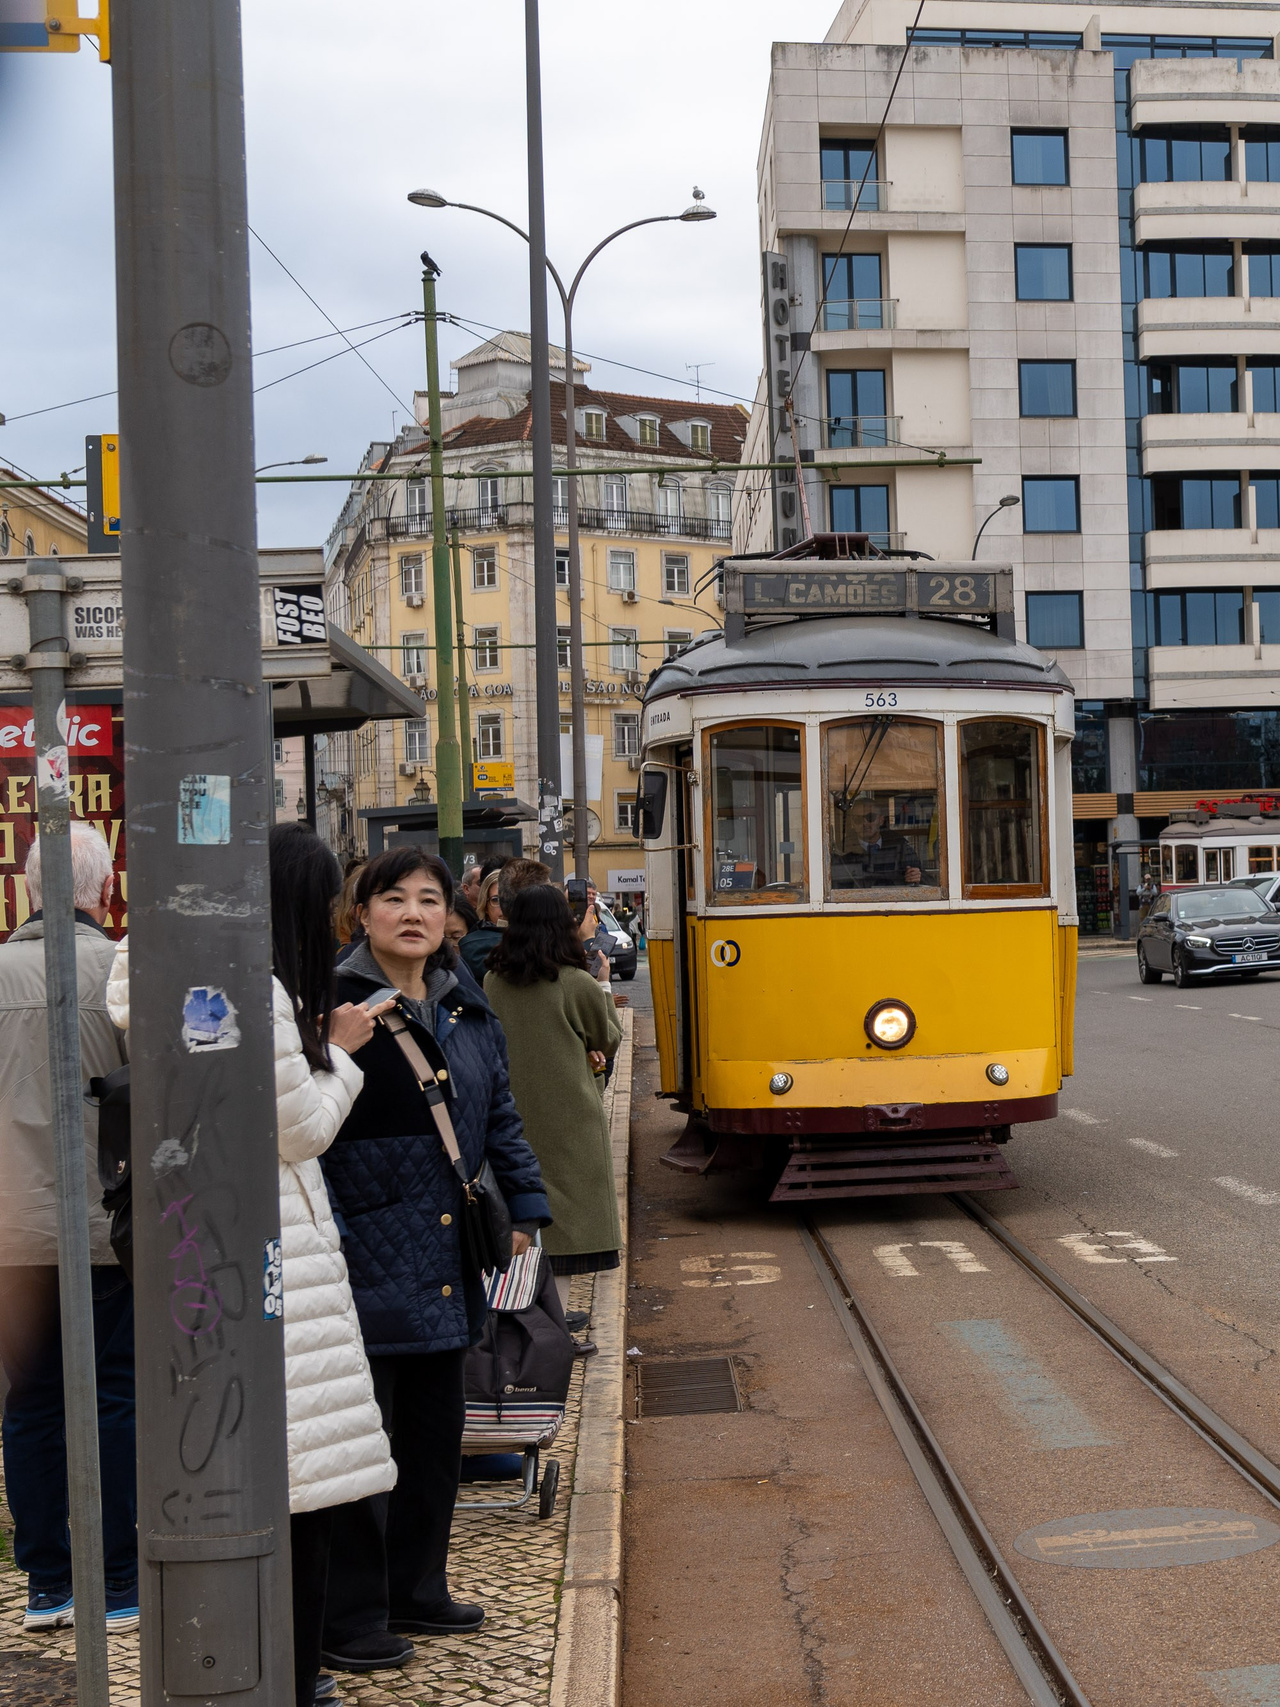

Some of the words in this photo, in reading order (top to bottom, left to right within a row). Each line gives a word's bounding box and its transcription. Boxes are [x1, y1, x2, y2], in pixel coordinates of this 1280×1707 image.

[772, 261, 793, 433] HOTEL
[754, 582, 775, 602] L.
[789, 581, 898, 604] CAMÕES
[929, 575, 977, 606] 28
[74, 625, 104, 638] WAS
[484, 683, 514, 697] GOA
[620, 681, 647, 694] NO
[864, 692, 898, 708] 563
[650, 711, 671, 727] ENTRADA
[0, 715, 102, 748] etic
[721, 864, 735, 873] 28E
[617, 875, 639, 884] Kamal
[719, 877, 733, 888] 05
